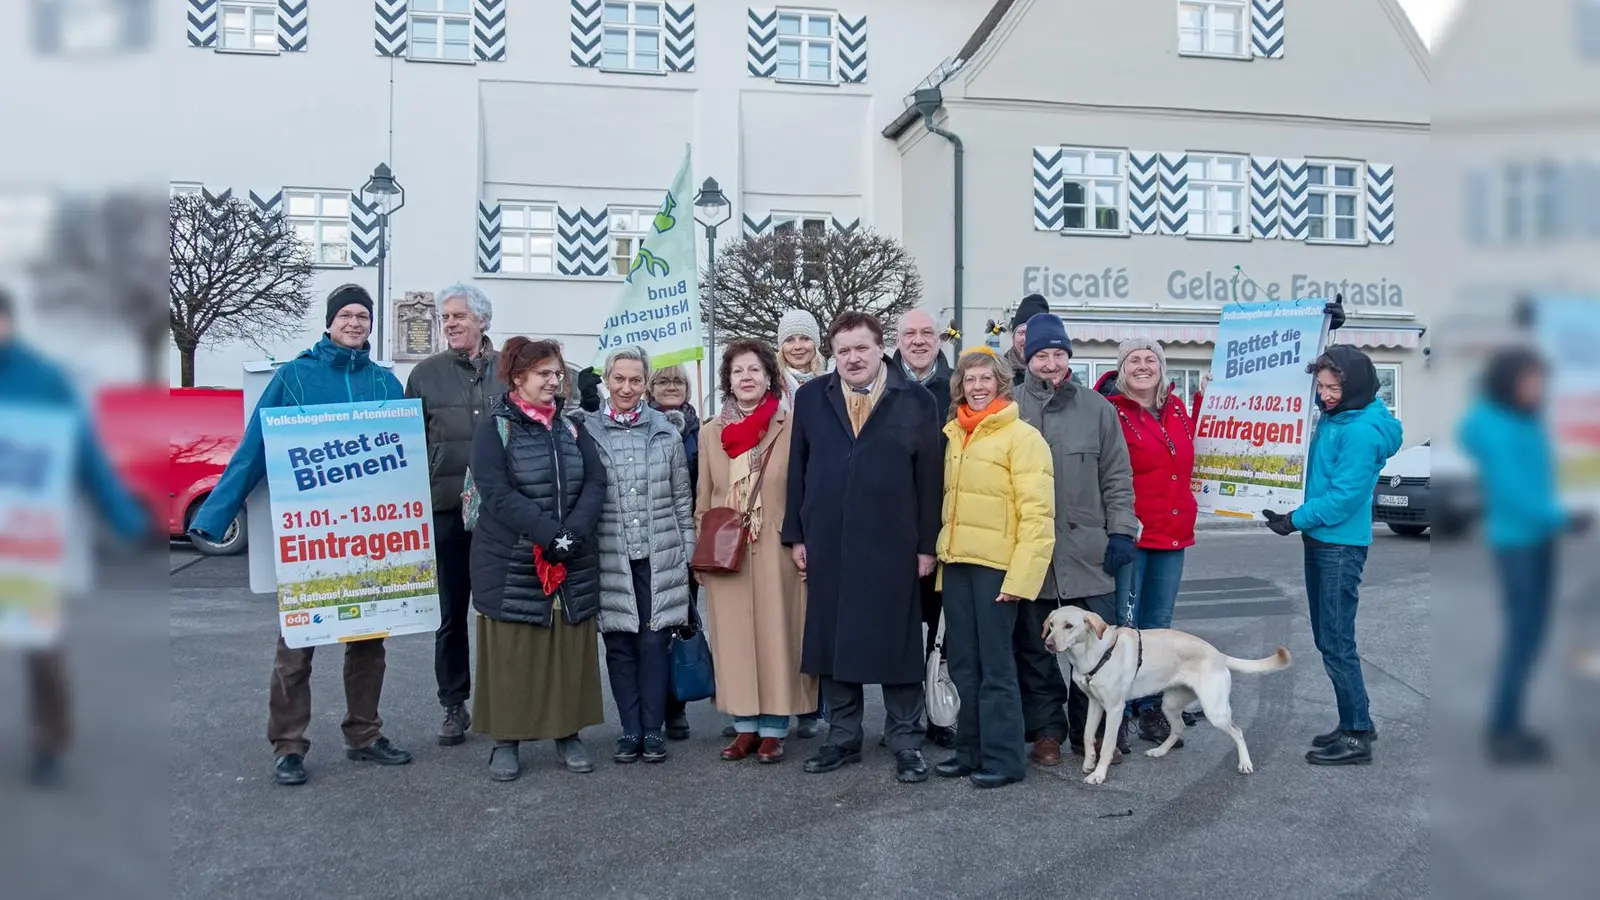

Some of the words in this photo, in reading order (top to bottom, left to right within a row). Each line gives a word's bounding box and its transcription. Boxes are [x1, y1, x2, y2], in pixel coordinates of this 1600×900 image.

[1022, 266, 1129, 299] Eiscafé
[1167, 270, 1258, 301] Gelato
[1266, 282, 1281, 301] e
[1291, 274, 1404, 307] Fantasia
[1225, 340, 1301, 379] Bienen!
[1226, 330, 1279, 359] Rettet
[1281, 329, 1301, 343] die
[266, 411, 350, 427] Volksbegehren
[352, 407, 419, 421] Artenvielfalt
[1207, 395, 1239, 410] 31.01.
[1248, 395, 1302, 412] 13.02.19
[1197, 414, 1304, 447] Eintragen!
[287, 434, 372, 469] Rettet
[374, 431, 401, 448] die
[293, 443, 408, 492] Bienen!
[282, 508, 338, 530] 31.01.
[350, 501, 424, 524] 13.02.19
[279, 523, 430, 563] Eintragen!
